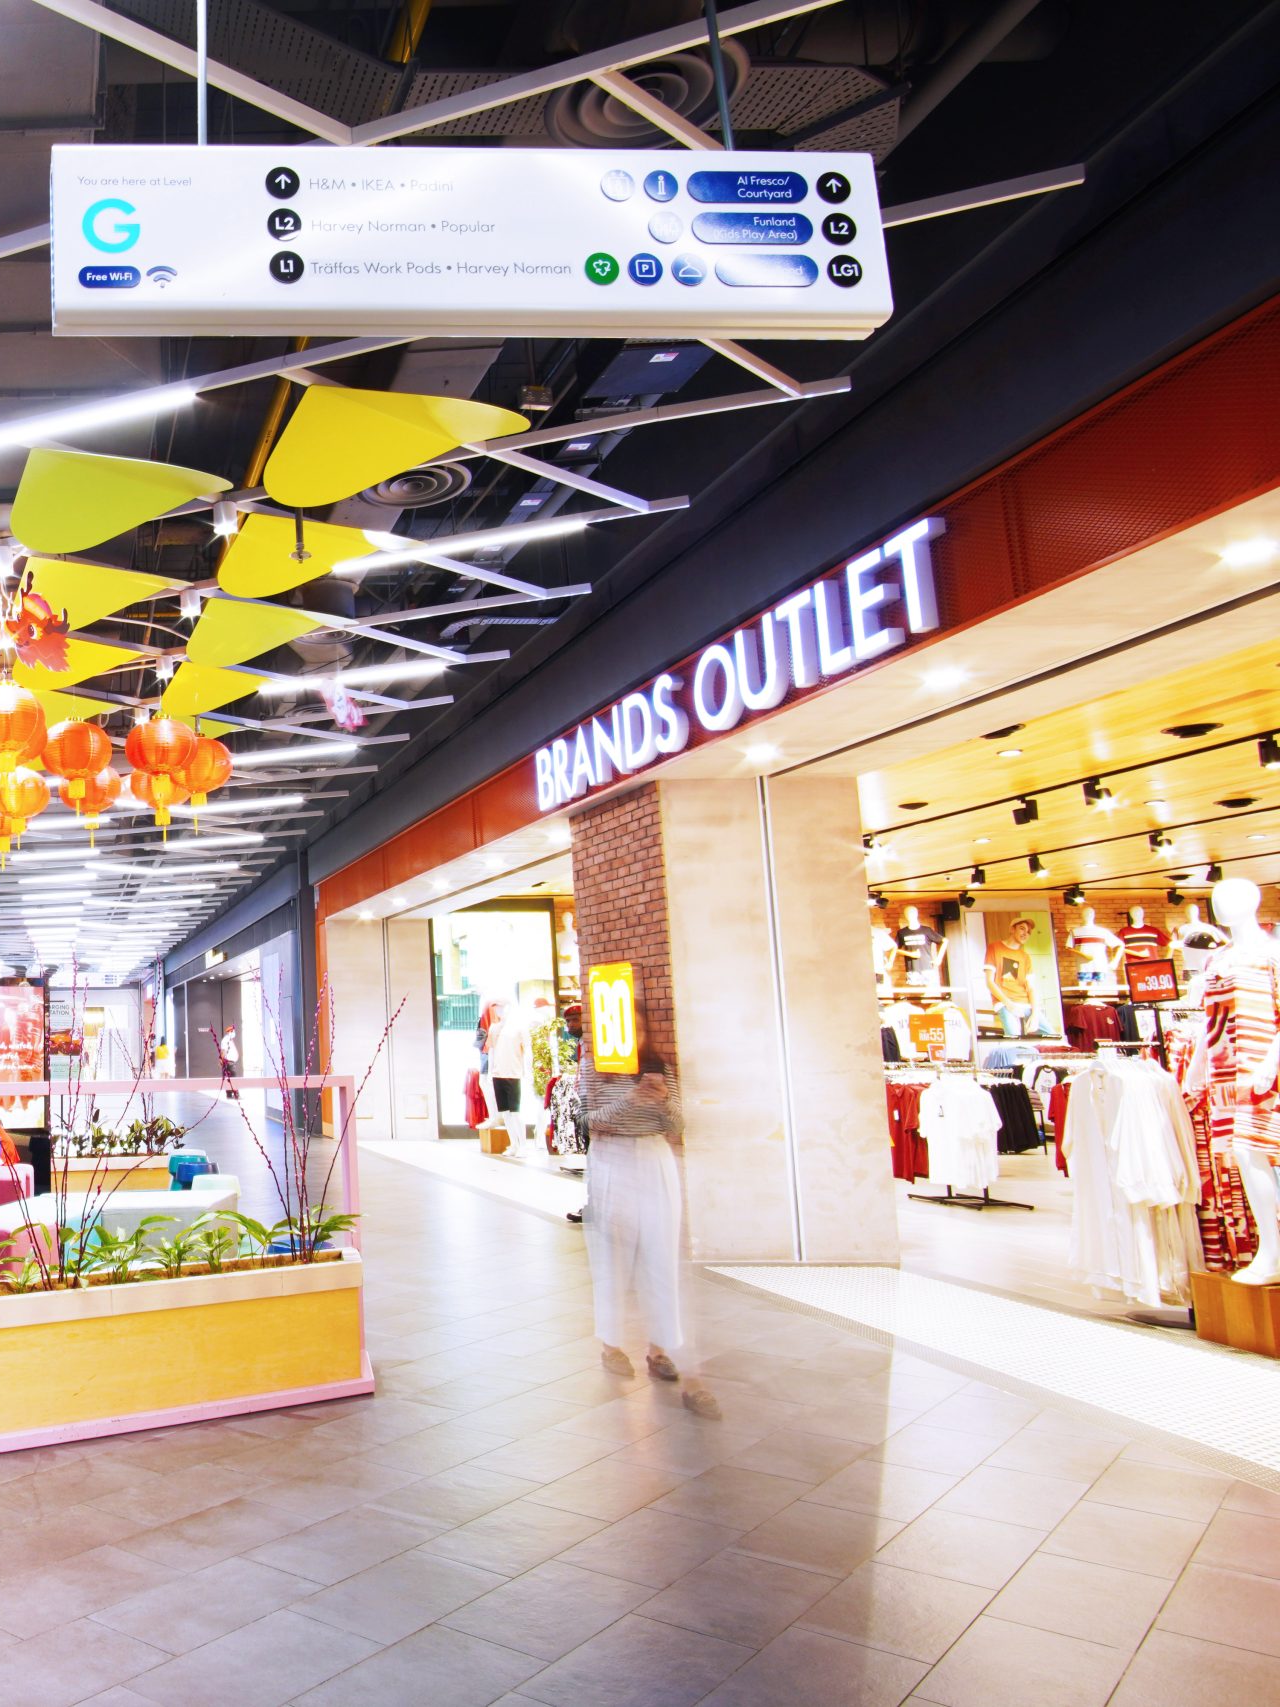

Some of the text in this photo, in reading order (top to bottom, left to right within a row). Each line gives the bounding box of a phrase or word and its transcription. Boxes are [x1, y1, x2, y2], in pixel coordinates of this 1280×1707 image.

[77, 176, 192, 187] You are here at Level
[309, 178, 454, 193] H&M IKEA Padini
[737, 176, 790, 187] Al Fresco/
[737, 188, 792, 201] Courtyard
[82, 197, 140, 254] G
[275, 217, 295, 231] L2
[311, 219, 495, 235] Harvey Norman Popular
[753, 217, 796, 227] Funland
[830, 222, 849, 235] L2
[742, 229, 766, 241] Play
[768, 229, 798, 241] Area)
[280, 259, 294, 273] L1
[311, 261, 571, 277] Träffas Work Pods Harvey Norman
[832, 263, 859, 277] LG1
[86, 272, 133, 281] Free Wi-Fi
[534, 517, 946, 812] BRANDS OUTLET
[593, 979, 634, 1057] BO
